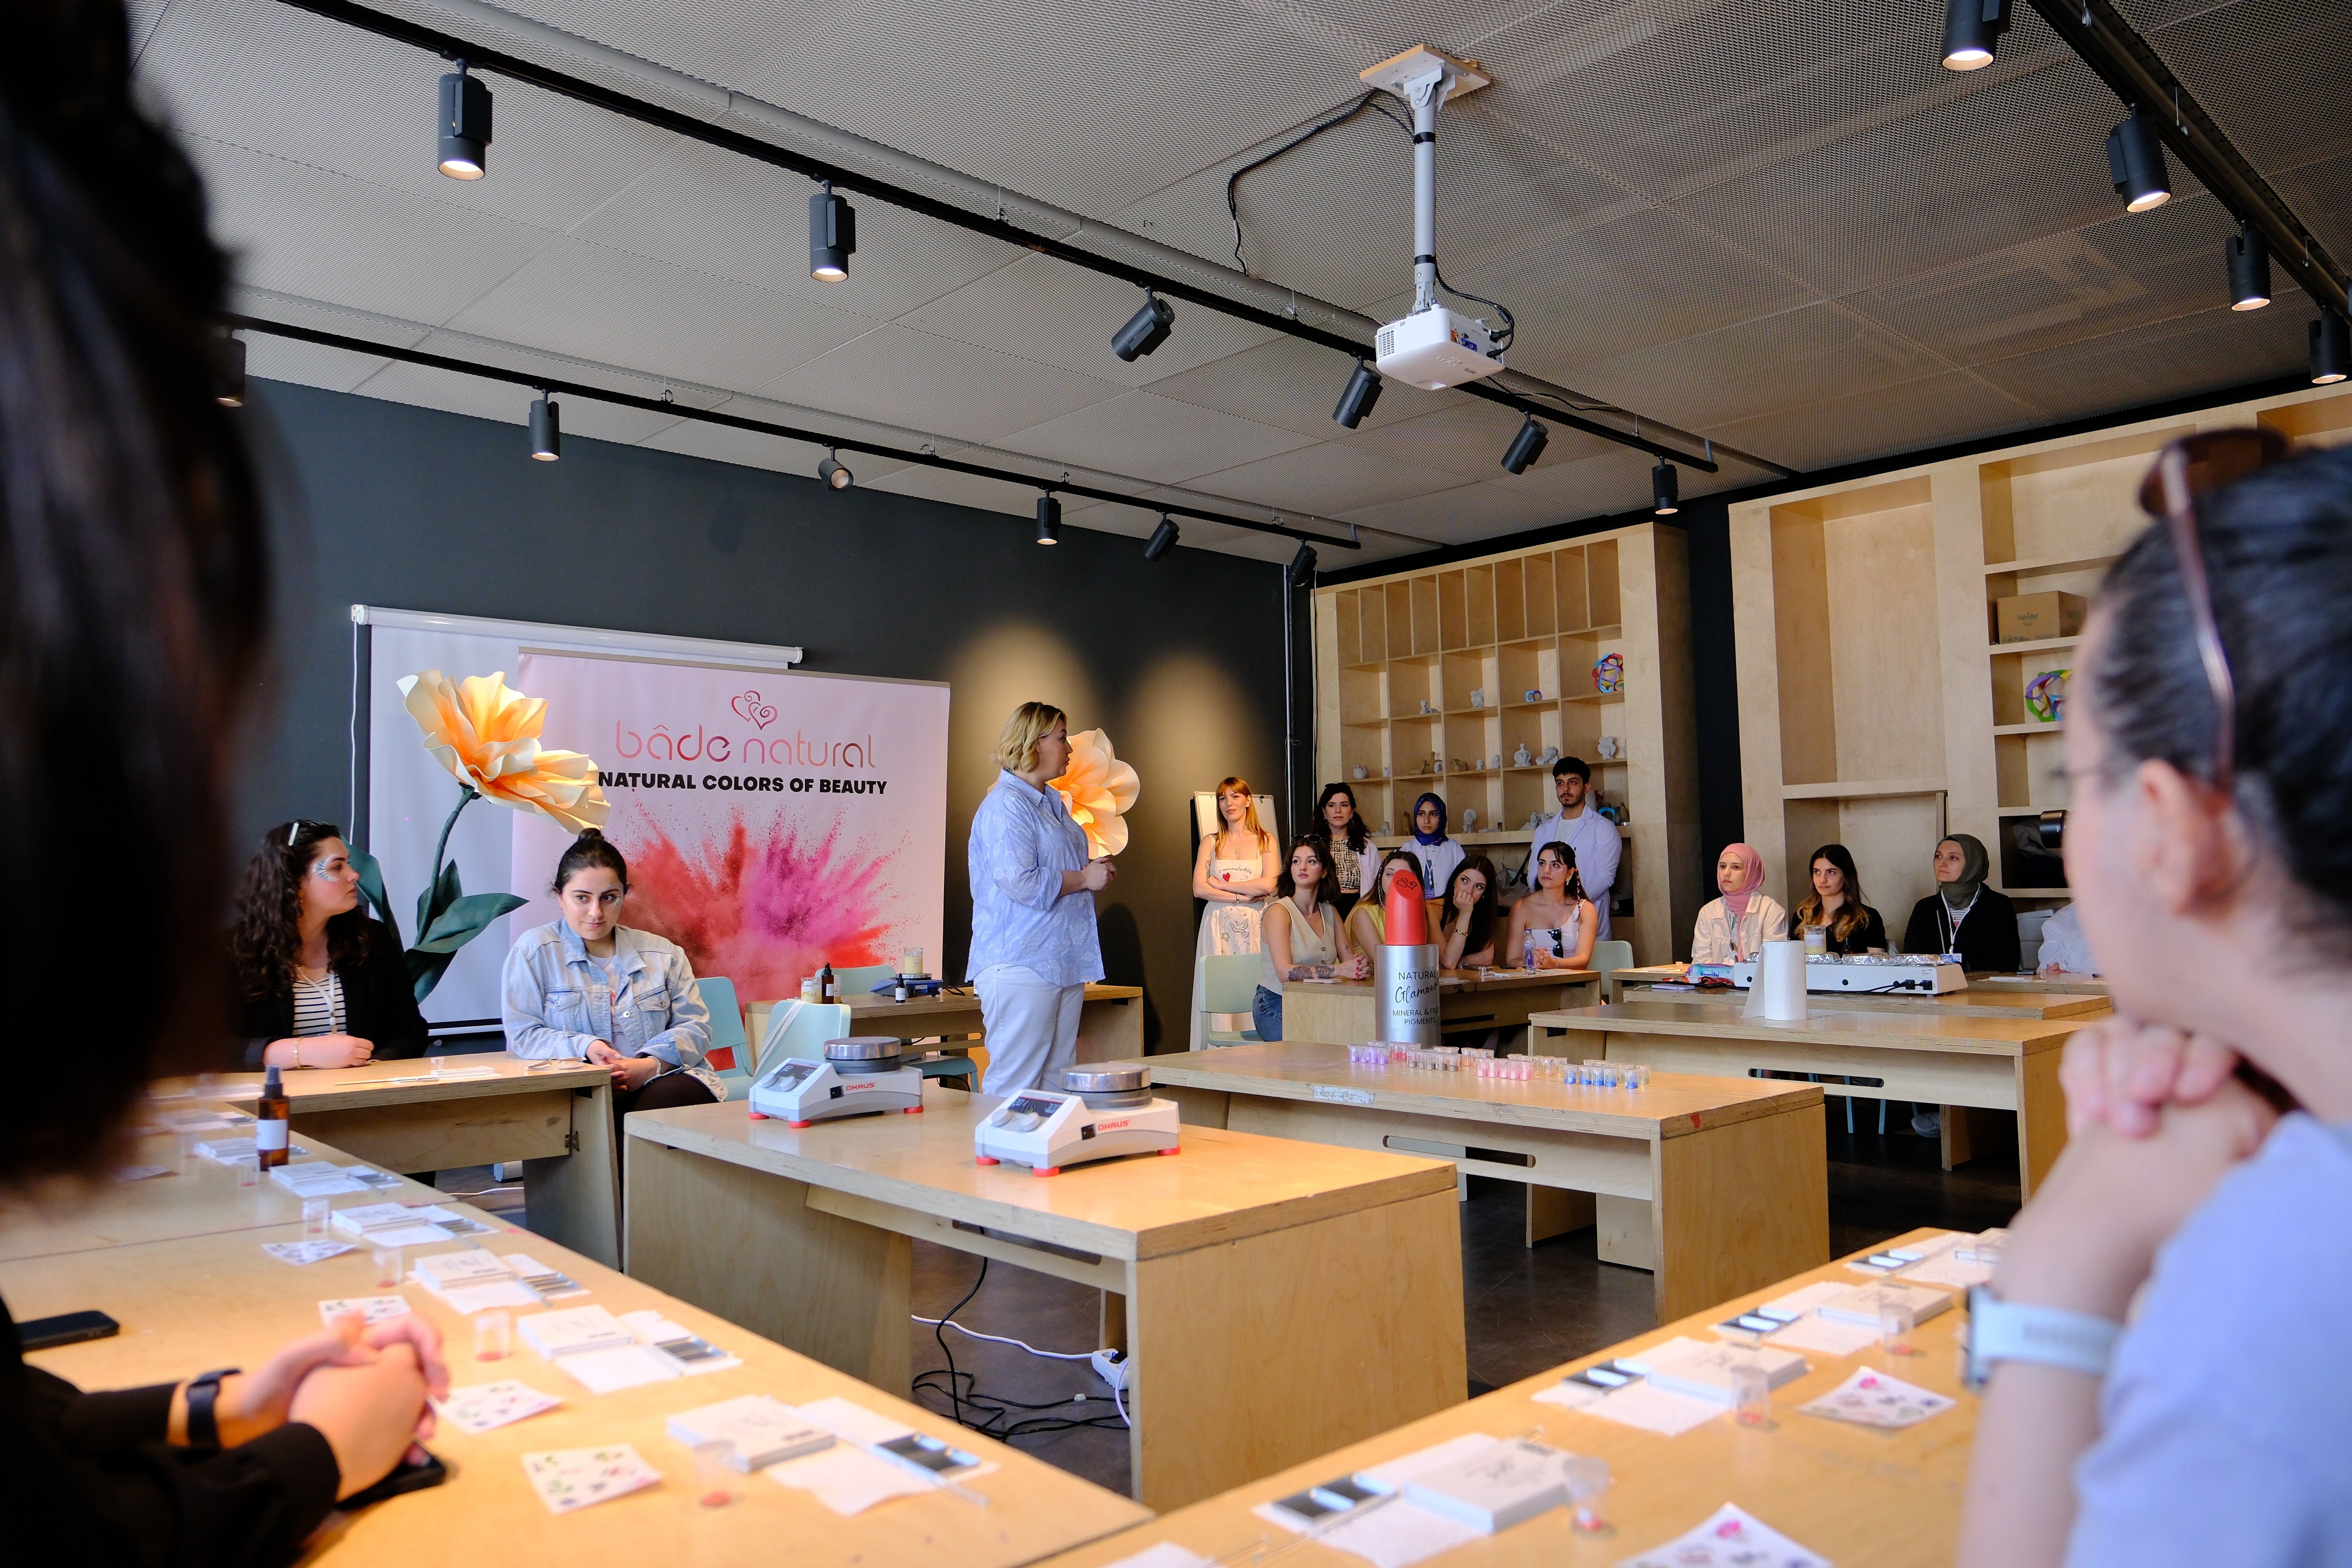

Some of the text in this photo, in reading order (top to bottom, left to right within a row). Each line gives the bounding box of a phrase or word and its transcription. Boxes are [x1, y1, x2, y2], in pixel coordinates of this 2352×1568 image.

[616, 719, 876, 768] bâde natural
[599, 772, 887, 795] NATURAL COLORS OF BEAUTY
[1399, 971, 1436, 980] NATURAL
[1395, 983, 1438, 1003] Glamour
[846, 1082, 875, 1091] OHAUS
[1098, 1120, 1129, 1131] OHAUS
